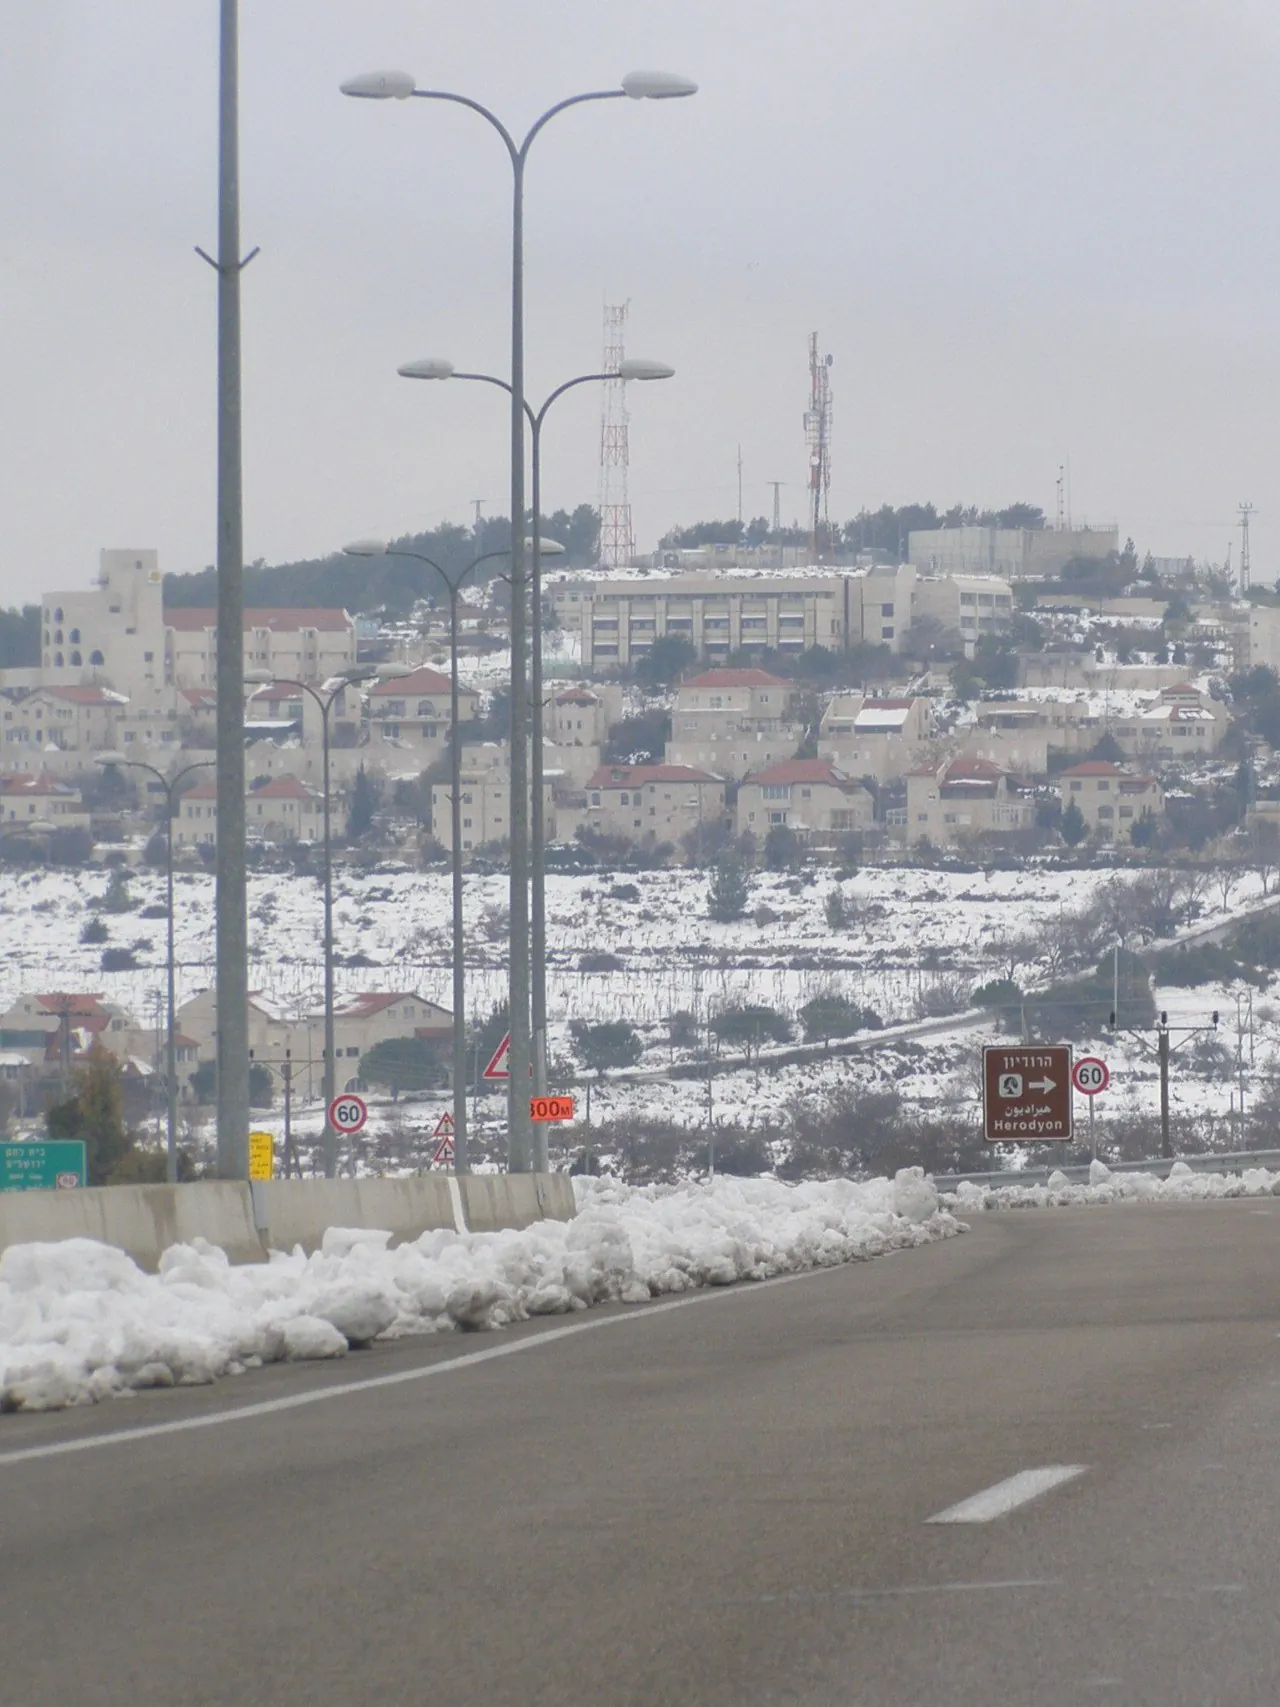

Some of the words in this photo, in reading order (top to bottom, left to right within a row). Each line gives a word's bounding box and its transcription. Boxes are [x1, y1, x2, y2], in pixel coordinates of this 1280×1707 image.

[1004, 1056, 1052, 1069] הרודיון
[1079, 1068, 1101, 1085] 60
[338, 1105, 360, 1122] 60
[994, 1120, 1062, 1132] Herodyon
